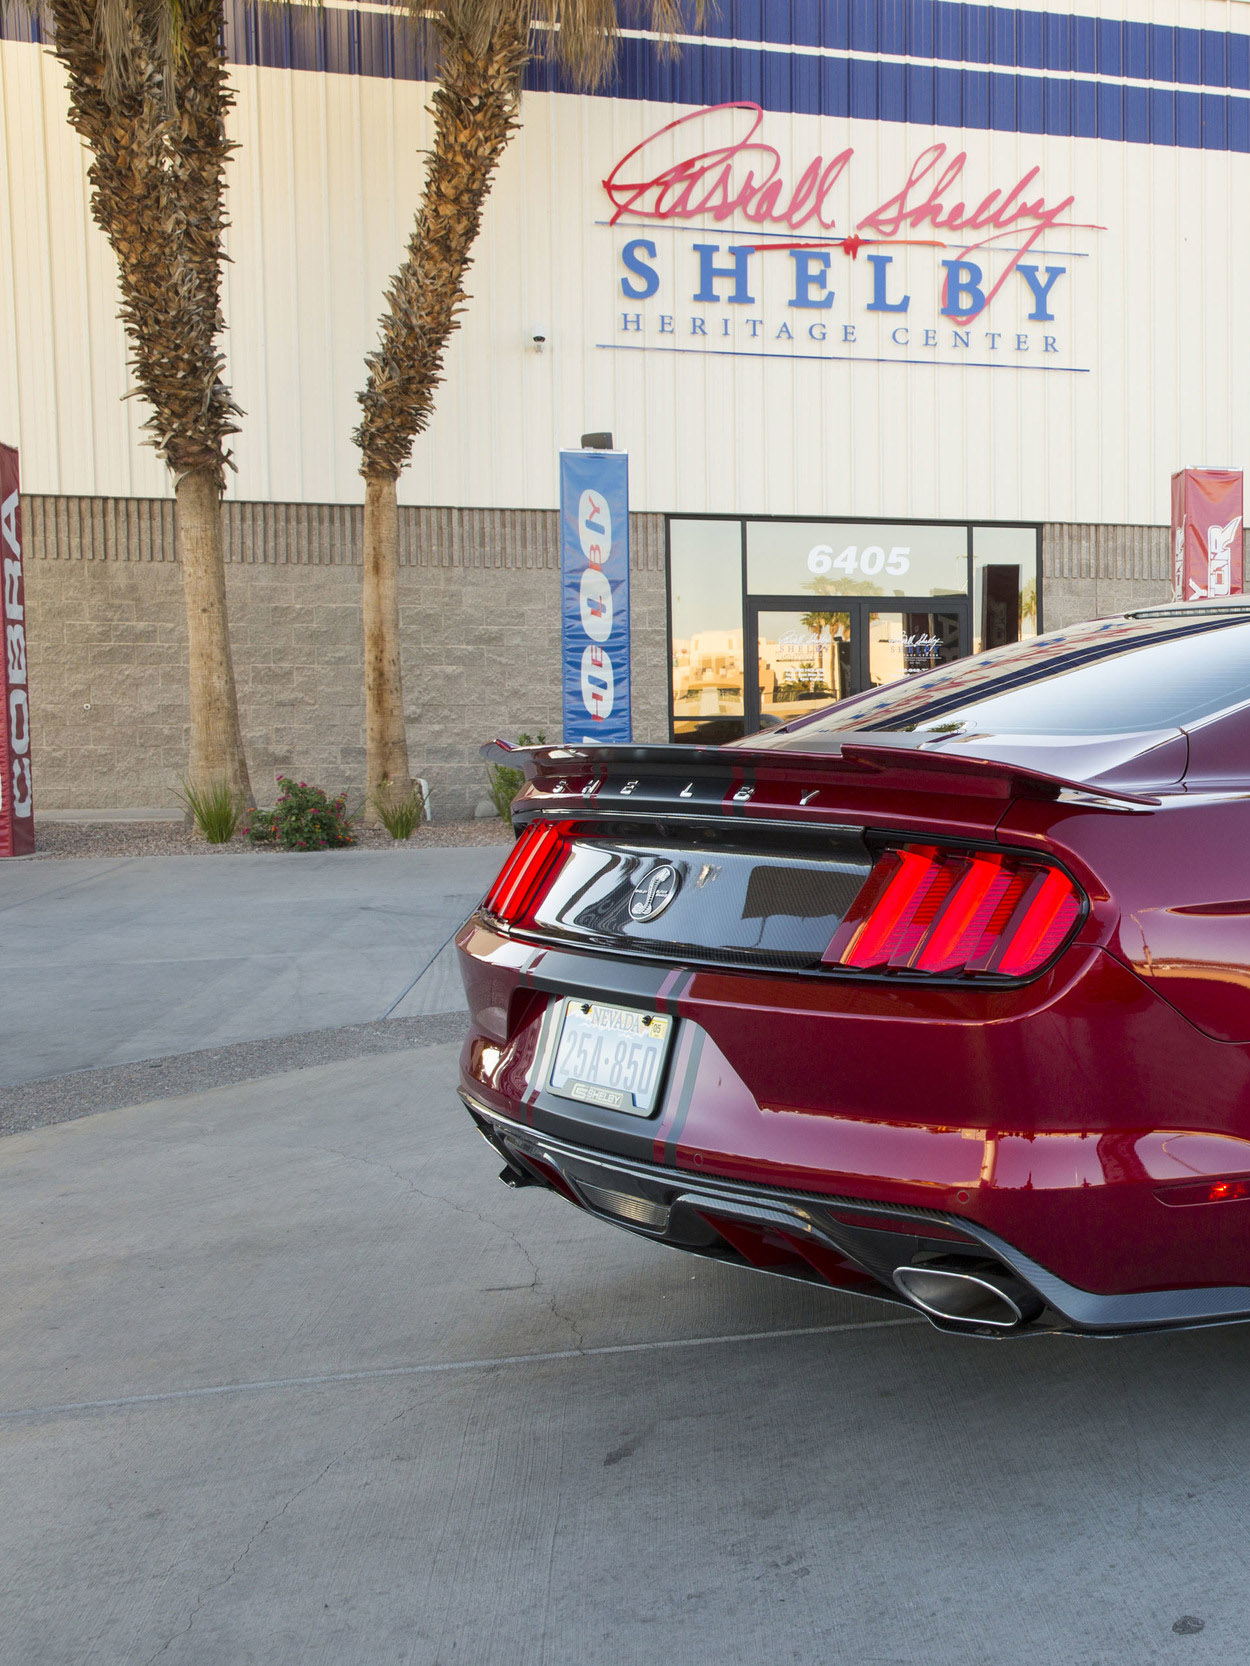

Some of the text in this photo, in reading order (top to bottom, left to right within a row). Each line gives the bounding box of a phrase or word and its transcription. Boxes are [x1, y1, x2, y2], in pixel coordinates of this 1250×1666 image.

[857, 143, 1108, 326] Shelby
[620, 239, 1067, 323] SHELBY
[621, 312, 1061, 355] HERITAGE CENTER
[806, 544, 911, 576] 6405
[587, 494, 604, 724] HELBY
[1, 488, 32, 819] COBRA
[552, 779, 820, 806] SHELBY
[590, 1006, 640, 1034] NEVADA
[586, 1087, 621, 1105] SHELBY
